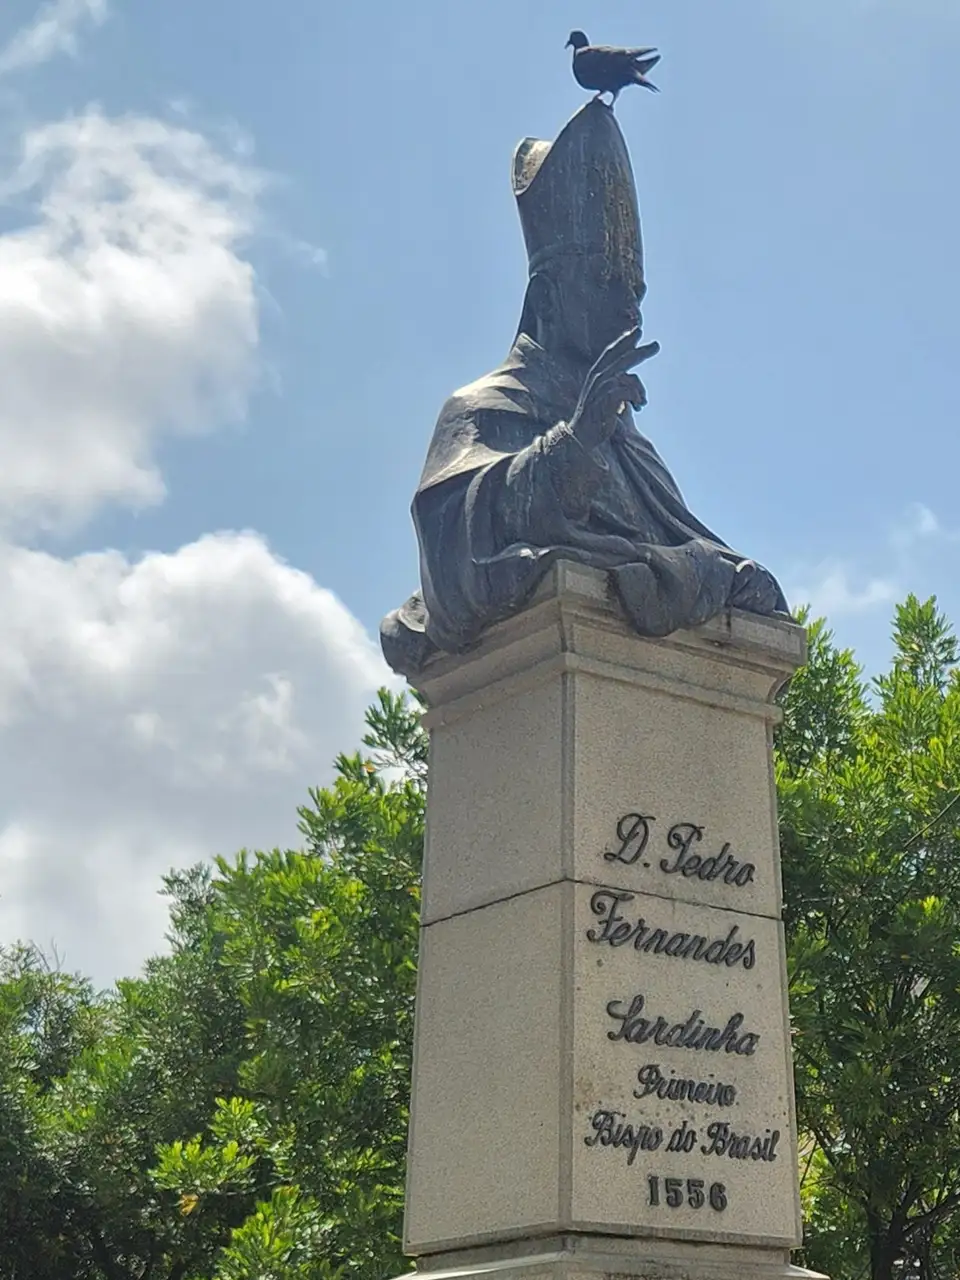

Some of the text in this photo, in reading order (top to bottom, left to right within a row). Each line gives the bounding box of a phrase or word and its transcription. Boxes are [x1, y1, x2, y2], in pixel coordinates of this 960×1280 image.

[604, 813, 756, 888] D. Pedro
[586, 890, 757, 971] Fernandes
[605, 994, 760, 1056] Sardinha
[633, 1064, 737, 1107] Primeiro
[584, 1111, 780, 1166] Bispo do Brasil
[647, 1174, 728, 1212] 1556
